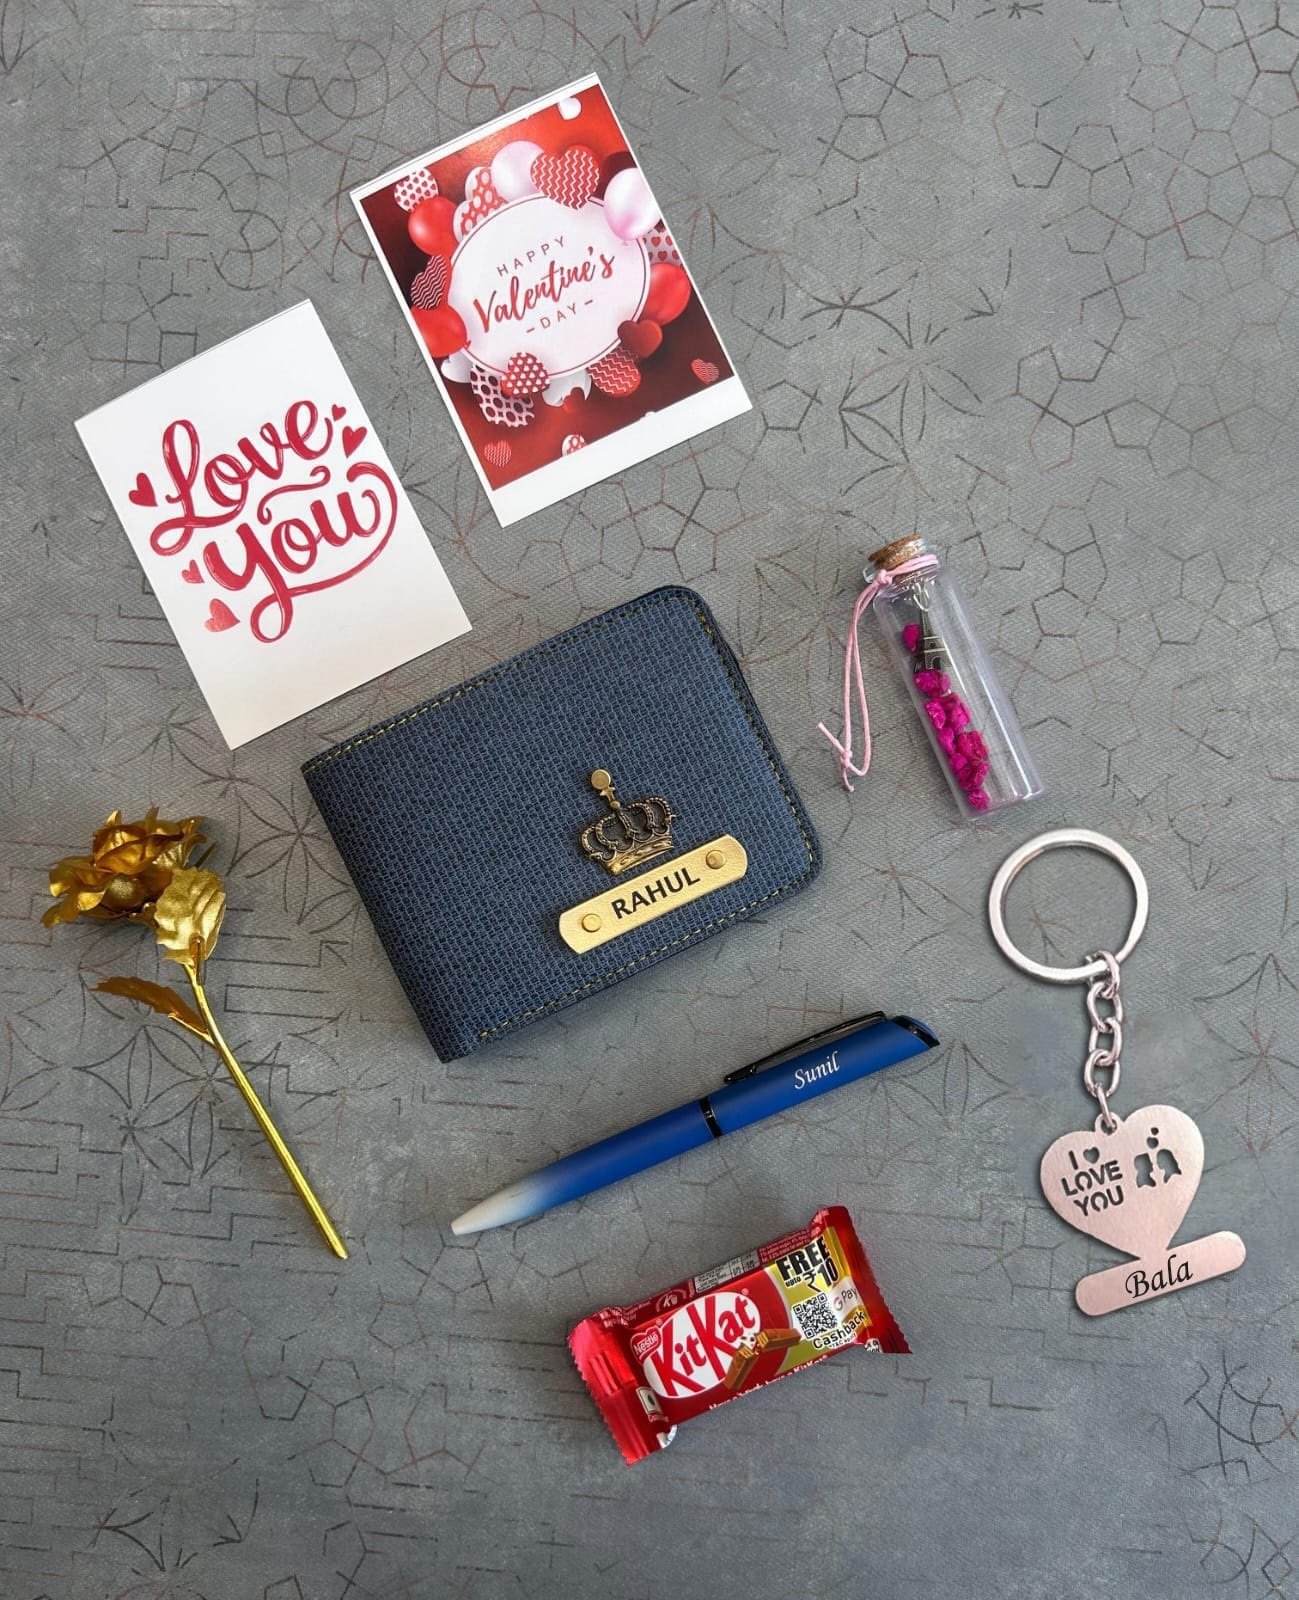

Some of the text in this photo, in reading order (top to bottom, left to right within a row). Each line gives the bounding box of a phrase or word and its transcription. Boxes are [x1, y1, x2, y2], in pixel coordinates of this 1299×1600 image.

[496, 236, 565, 277] HAPPY
[473, 246, 615, 333] Valentine's
[150, 400, 333, 556] Love
[203, 462, 398, 643] You
[611, 867, 701, 920] RAHUL
[794, 1050, 840, 1090] Sunil
[1061, 1160, 1123, 1197] LOVE
[1068, 1150, 1079, 1170] I
[1073, 1185, 1125, 1217] YOU
[775, 1236, 831, 1282] FREE
[1125, 1254, 1194, 1299] Bala
[813, 1311, 865, 1349] Cashback
